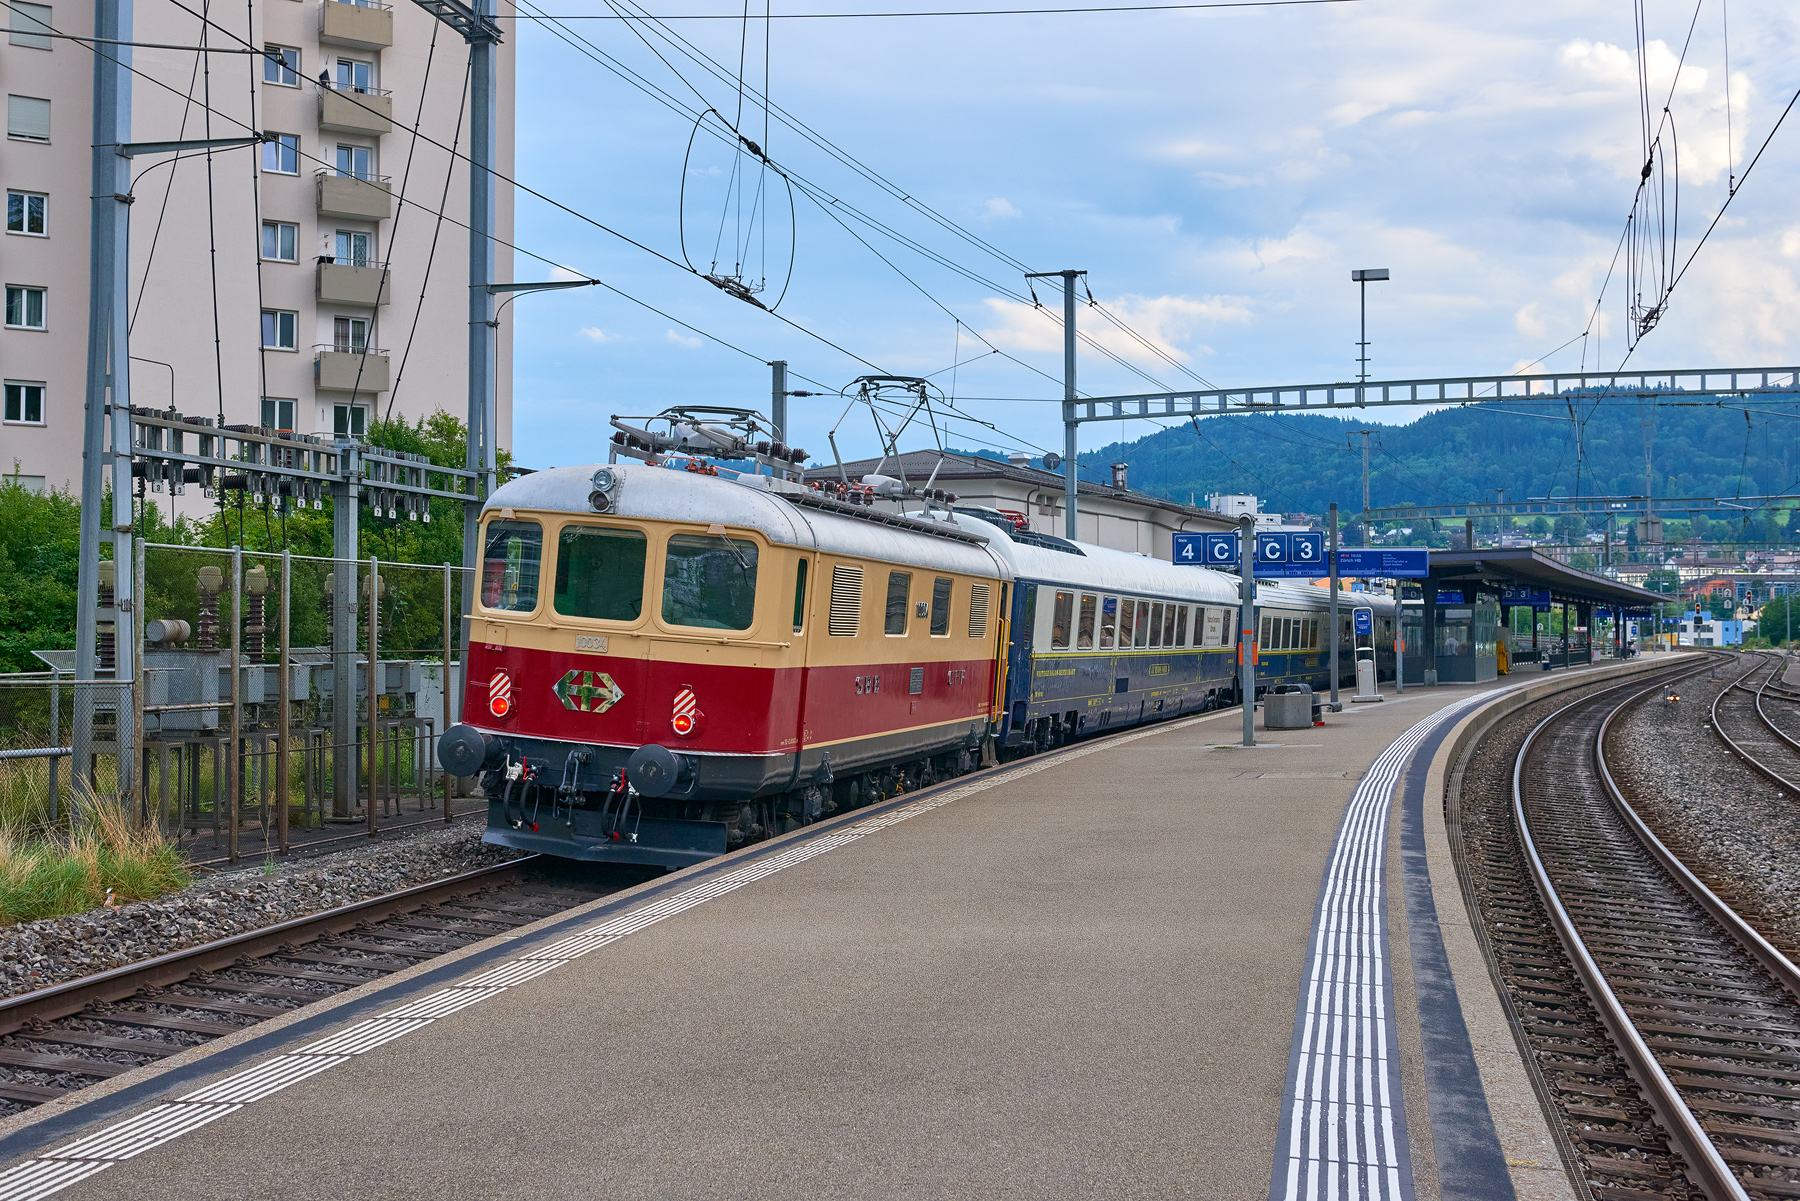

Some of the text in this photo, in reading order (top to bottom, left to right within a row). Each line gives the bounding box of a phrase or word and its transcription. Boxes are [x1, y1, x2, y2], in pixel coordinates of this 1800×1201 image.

[1182, 543, 1195, 560] 4
[1214, 542, 1229, 560] C
[1265, 542, 1281, 559] C
[1300, 541, 1313, 559] 3
[1410, 590, 1417, 598] D
[1505, 590, 1512, 598] D
[1520, 590, 1526, 598] 3
[577, 635, 606, 649] 10034
[855, 675, 880, 695] SBB
[947, 669, 966, 686] CFF
